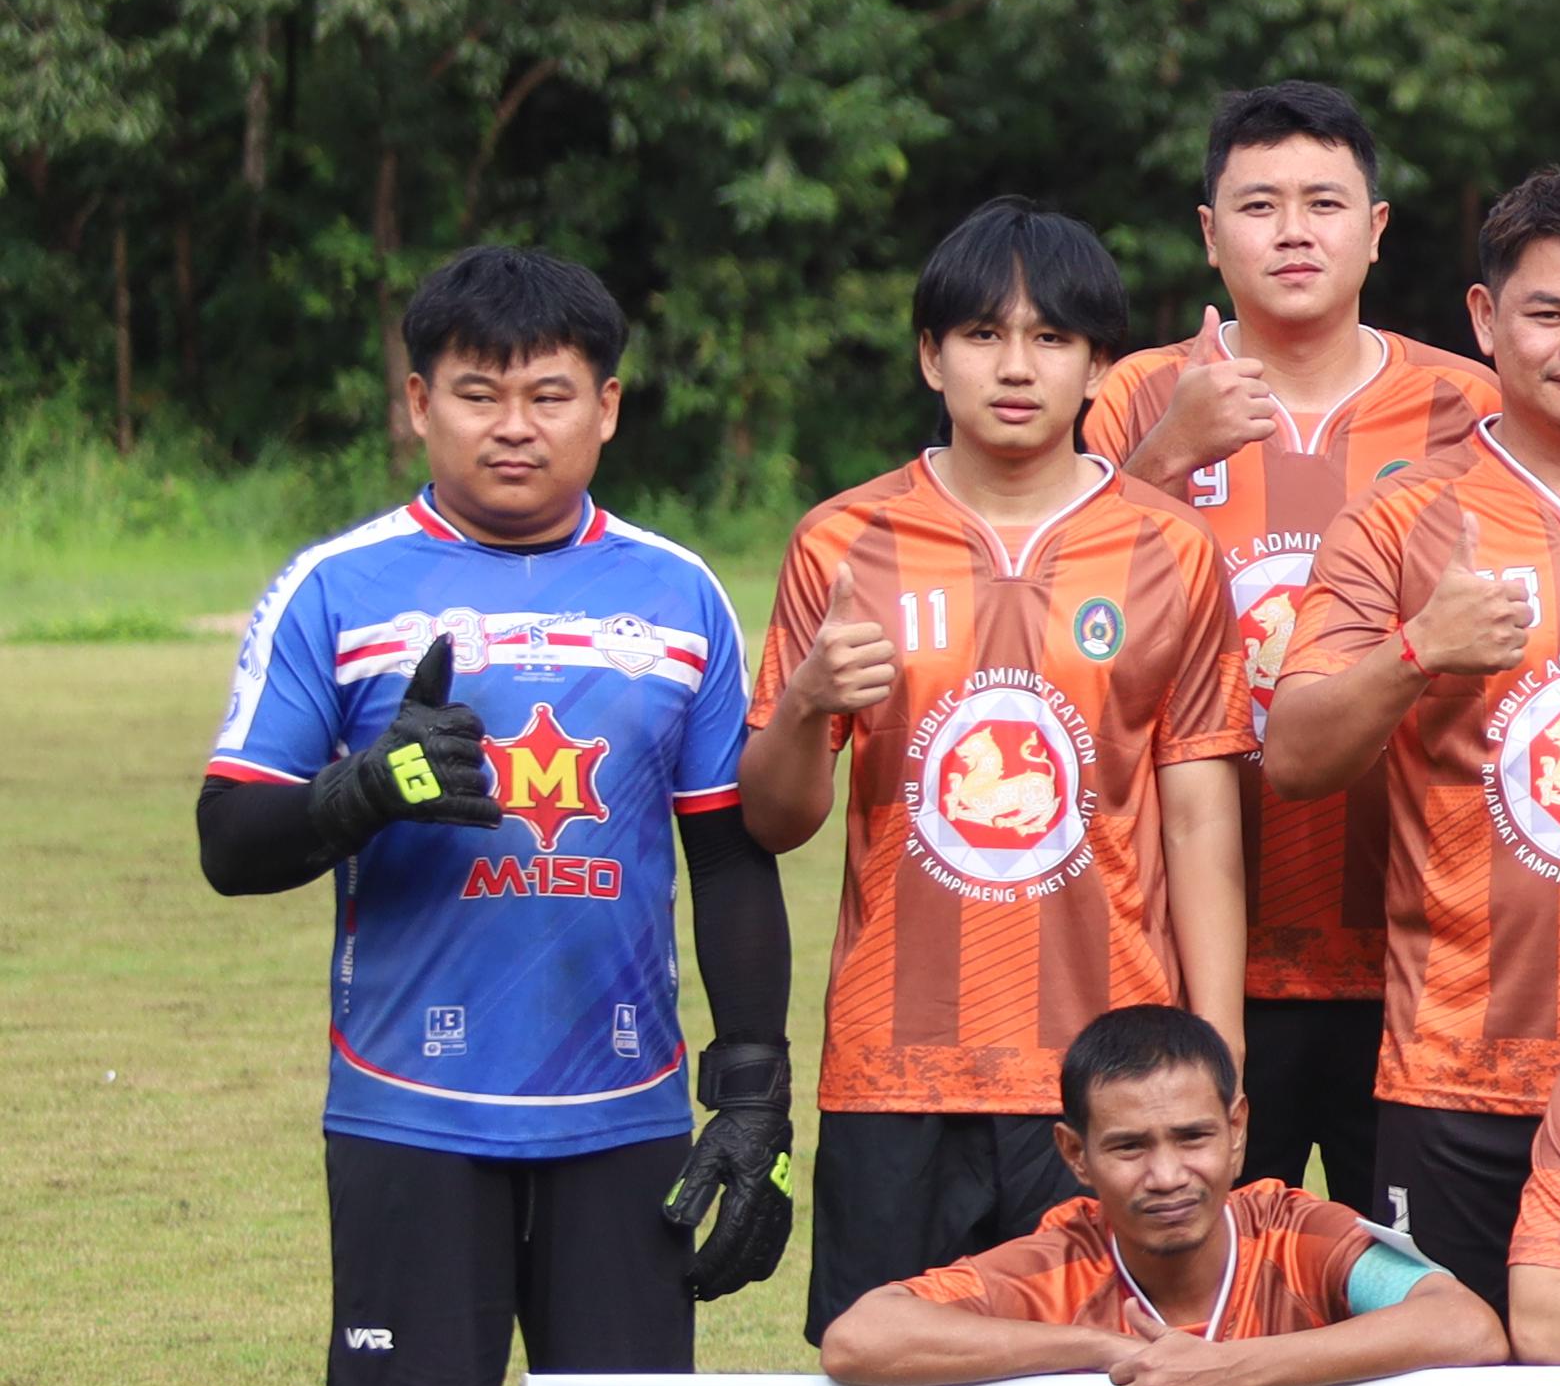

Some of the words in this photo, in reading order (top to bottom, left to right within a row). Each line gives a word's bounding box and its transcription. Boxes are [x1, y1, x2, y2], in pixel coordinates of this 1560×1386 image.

[899, 588, 947, 652] 11
[906, 688, 963, 762] PUBLIC
[964, 666, 1098, 766] ADMINISTRATION
[1486, 669, 1543, 744] PUBLIC
[459, 855, 622, 901] M-150
[920, 854, 1017, 903] KAMPHAENG
[1026, 871, 1067, 900] PHET
[344, 1327, 395, 1351] VAR
